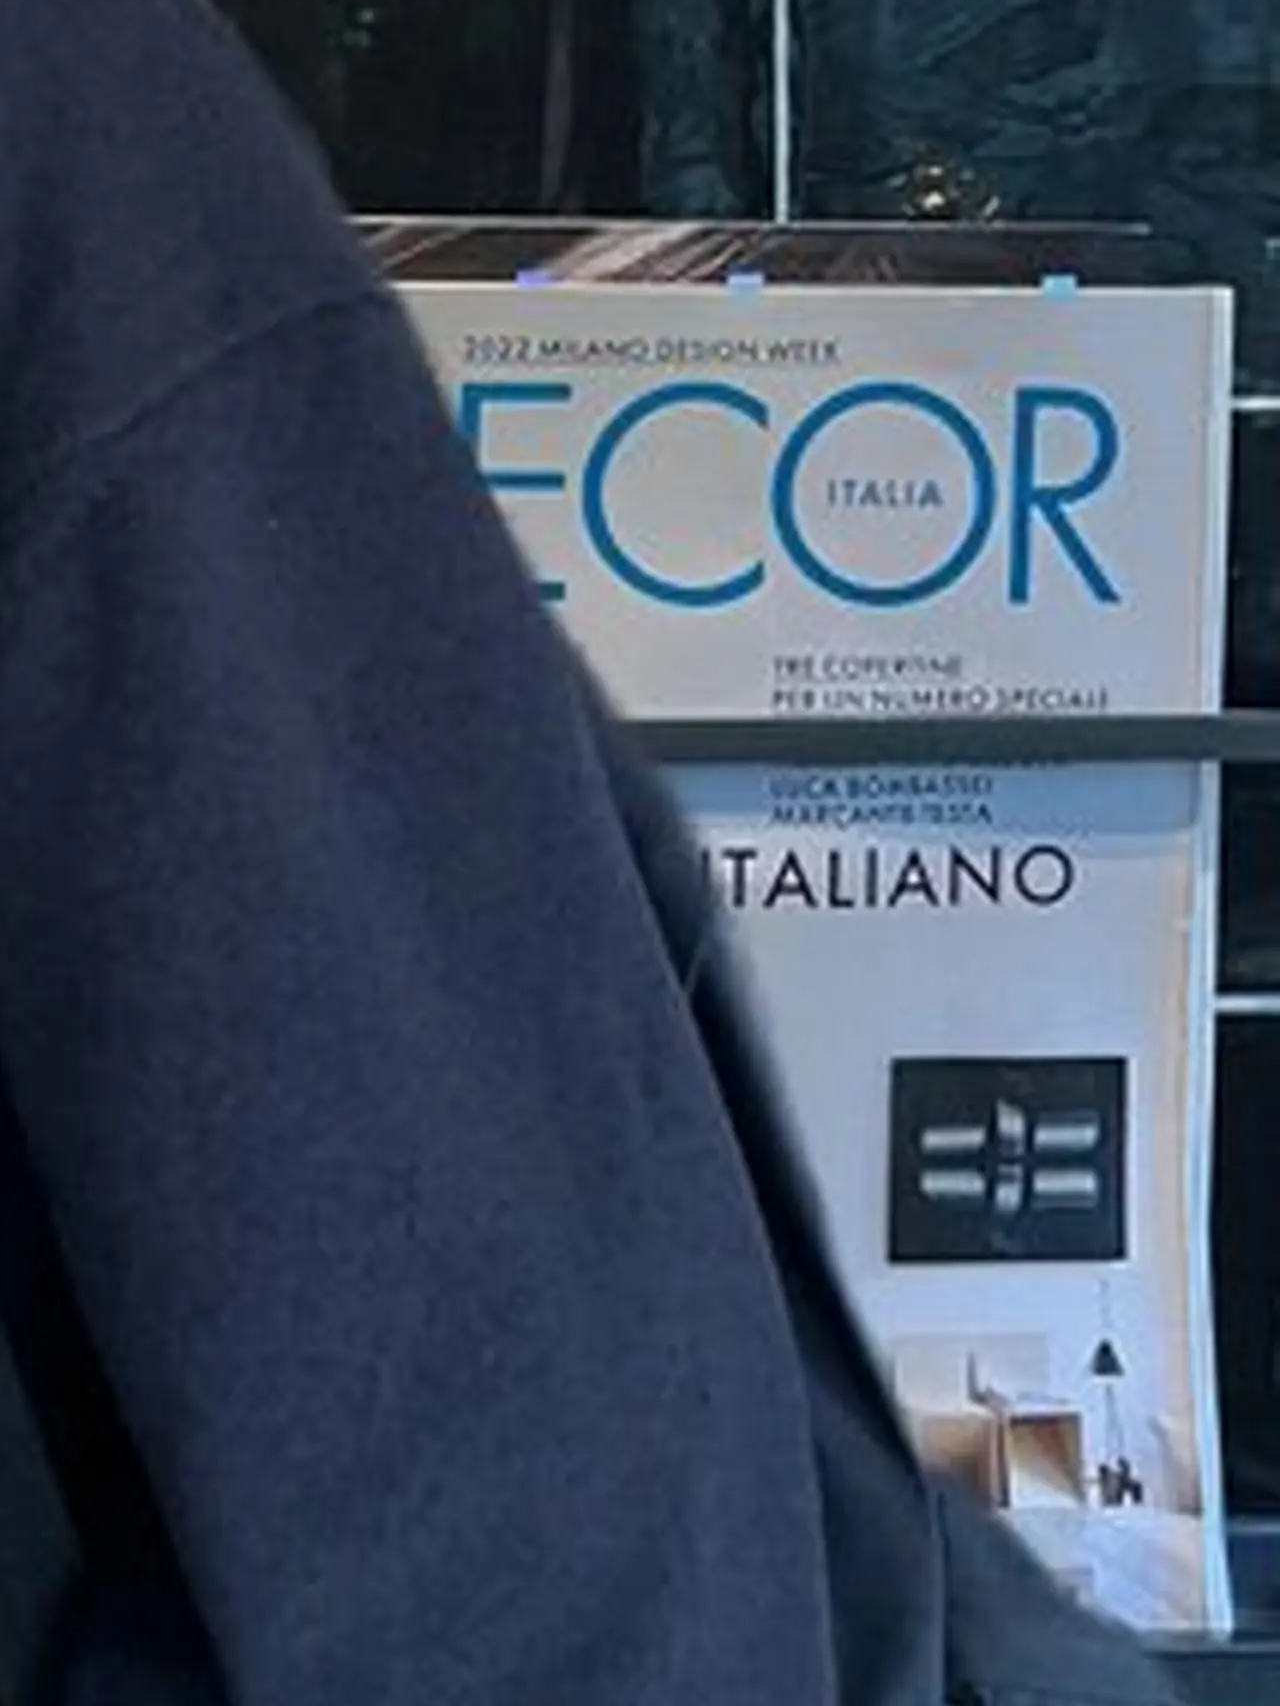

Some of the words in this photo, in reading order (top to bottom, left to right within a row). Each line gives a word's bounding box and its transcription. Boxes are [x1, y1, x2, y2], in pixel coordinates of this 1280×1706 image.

[462, 334, 529, 363] 2022
[539, 335, 650, 364] MILANO
[657, 335, 759, 363] DESIGN
[767, 336, 841, 363] WEEK
[826, 477, 944, 509] ITALIA
[700, 844, 1076, 909] ITALIANO
